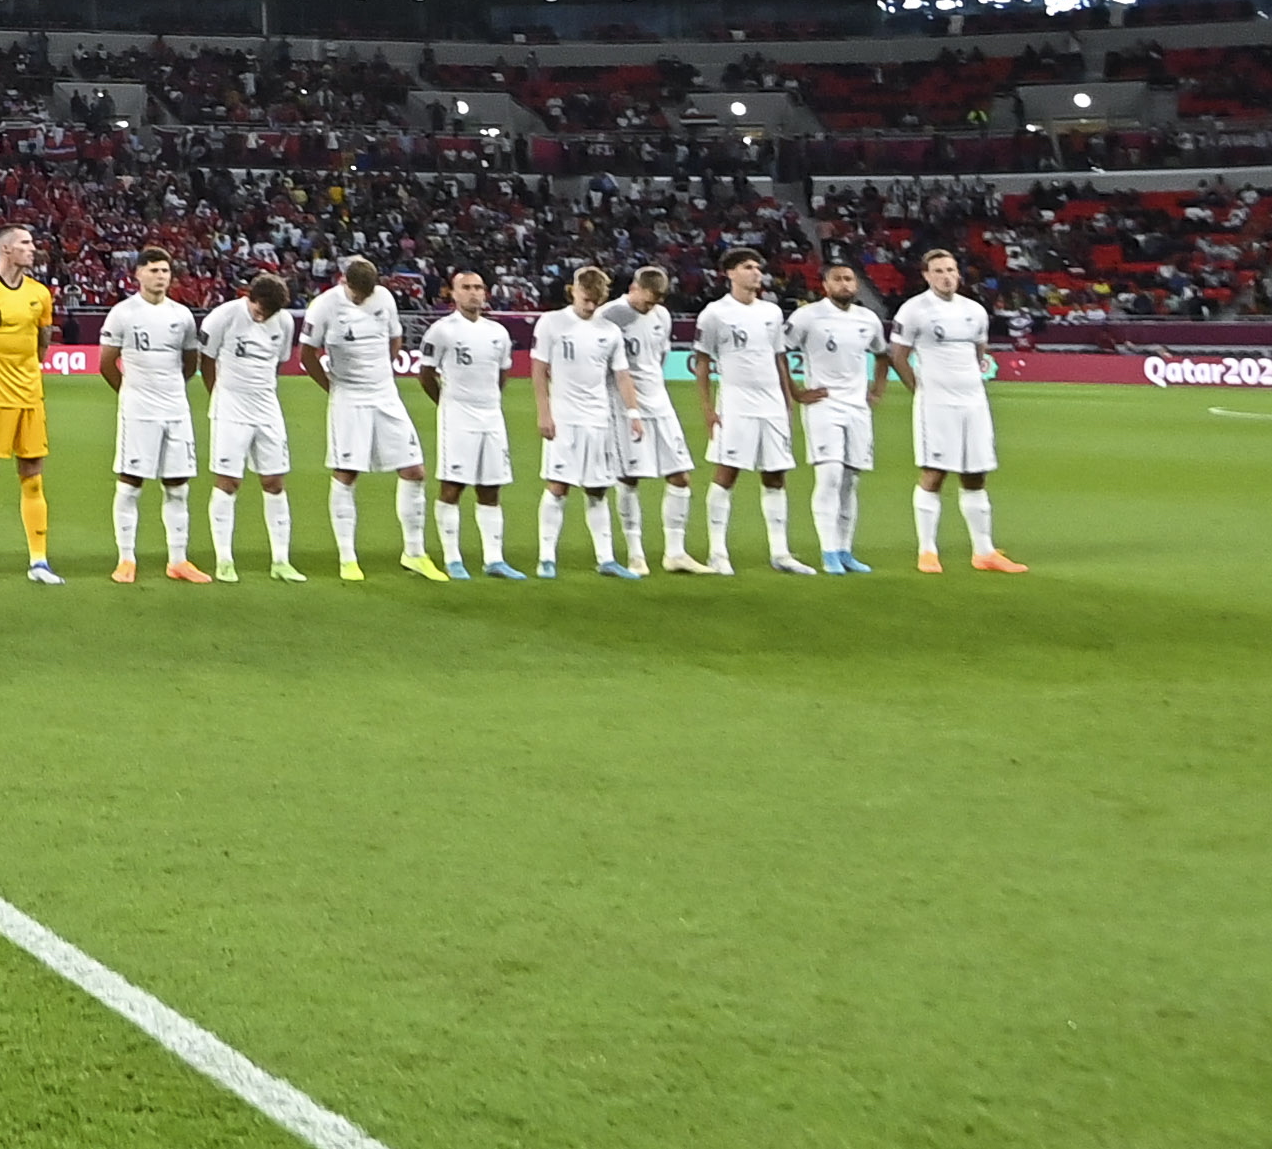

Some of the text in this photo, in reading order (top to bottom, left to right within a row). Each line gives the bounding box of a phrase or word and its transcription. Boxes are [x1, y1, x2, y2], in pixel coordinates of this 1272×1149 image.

[134, 331, 150, 351] 13
[563, 341, 574, 360] 11
[826, 335, 837, 353] 6
[455, 347, 473, 365] 15
[1144, 356, 1272, 388] Qatar202
